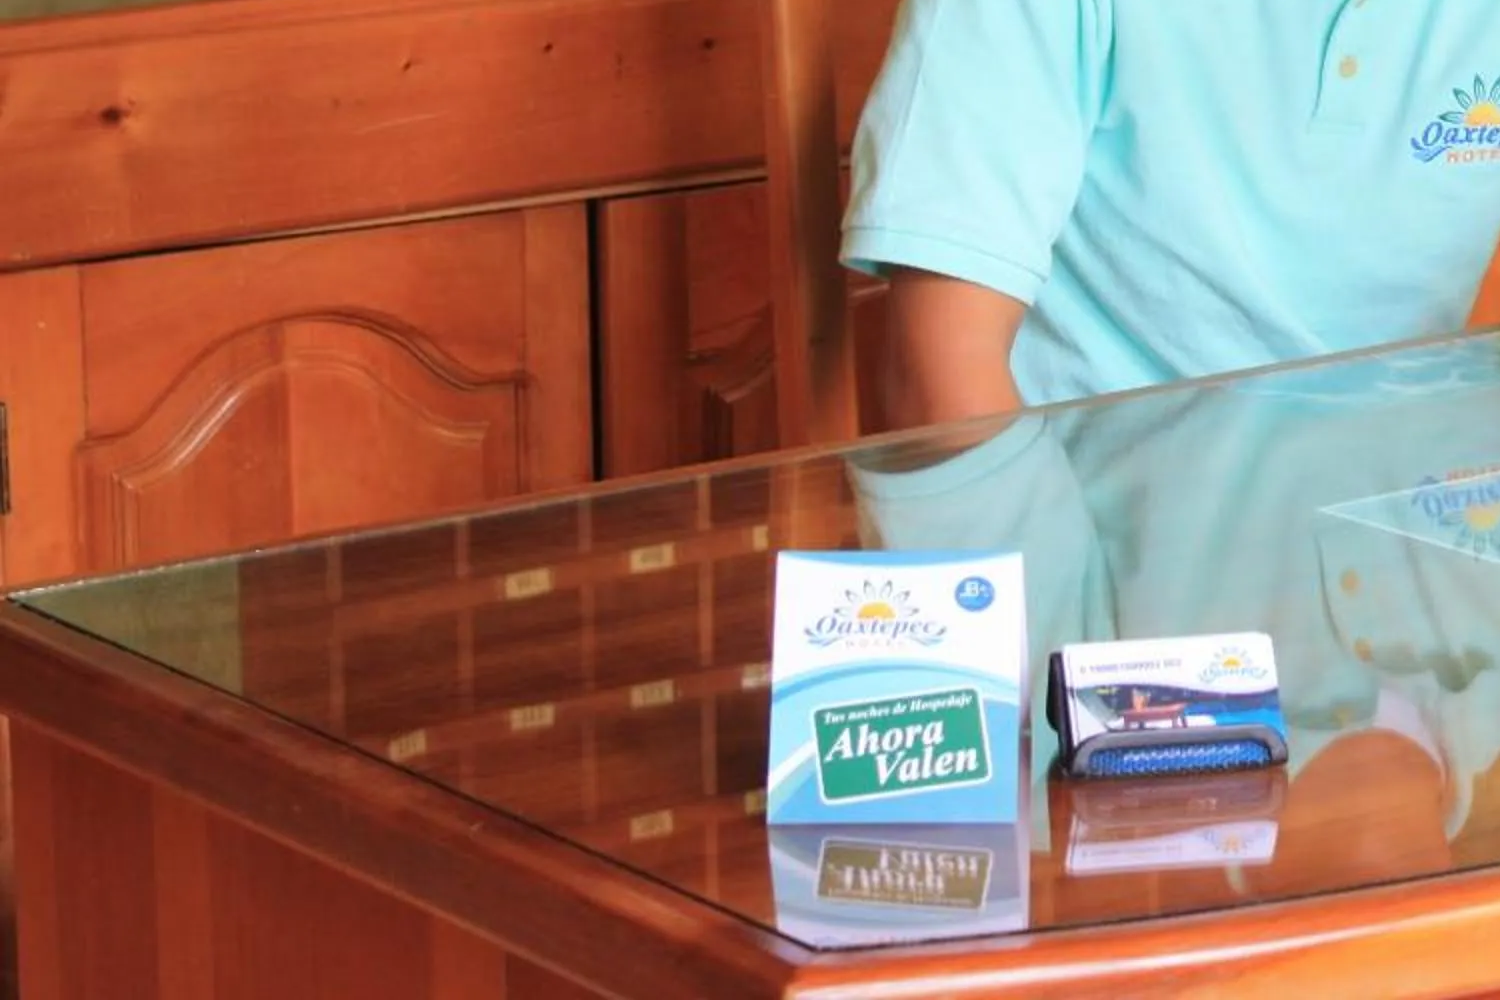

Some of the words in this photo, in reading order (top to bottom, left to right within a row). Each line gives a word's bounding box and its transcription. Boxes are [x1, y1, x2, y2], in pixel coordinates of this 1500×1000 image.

[815, 614, 937, 640] Oaxtepec
[823, 711, 845, 726] Tus
[848, 704, 890, 721] noches
[892, 702, 908, 716] de
[909, 692, 973, 713] Hospedaje
[823, 720, 944, 763] Ahora
[874, 746, 979, 787] Valen
